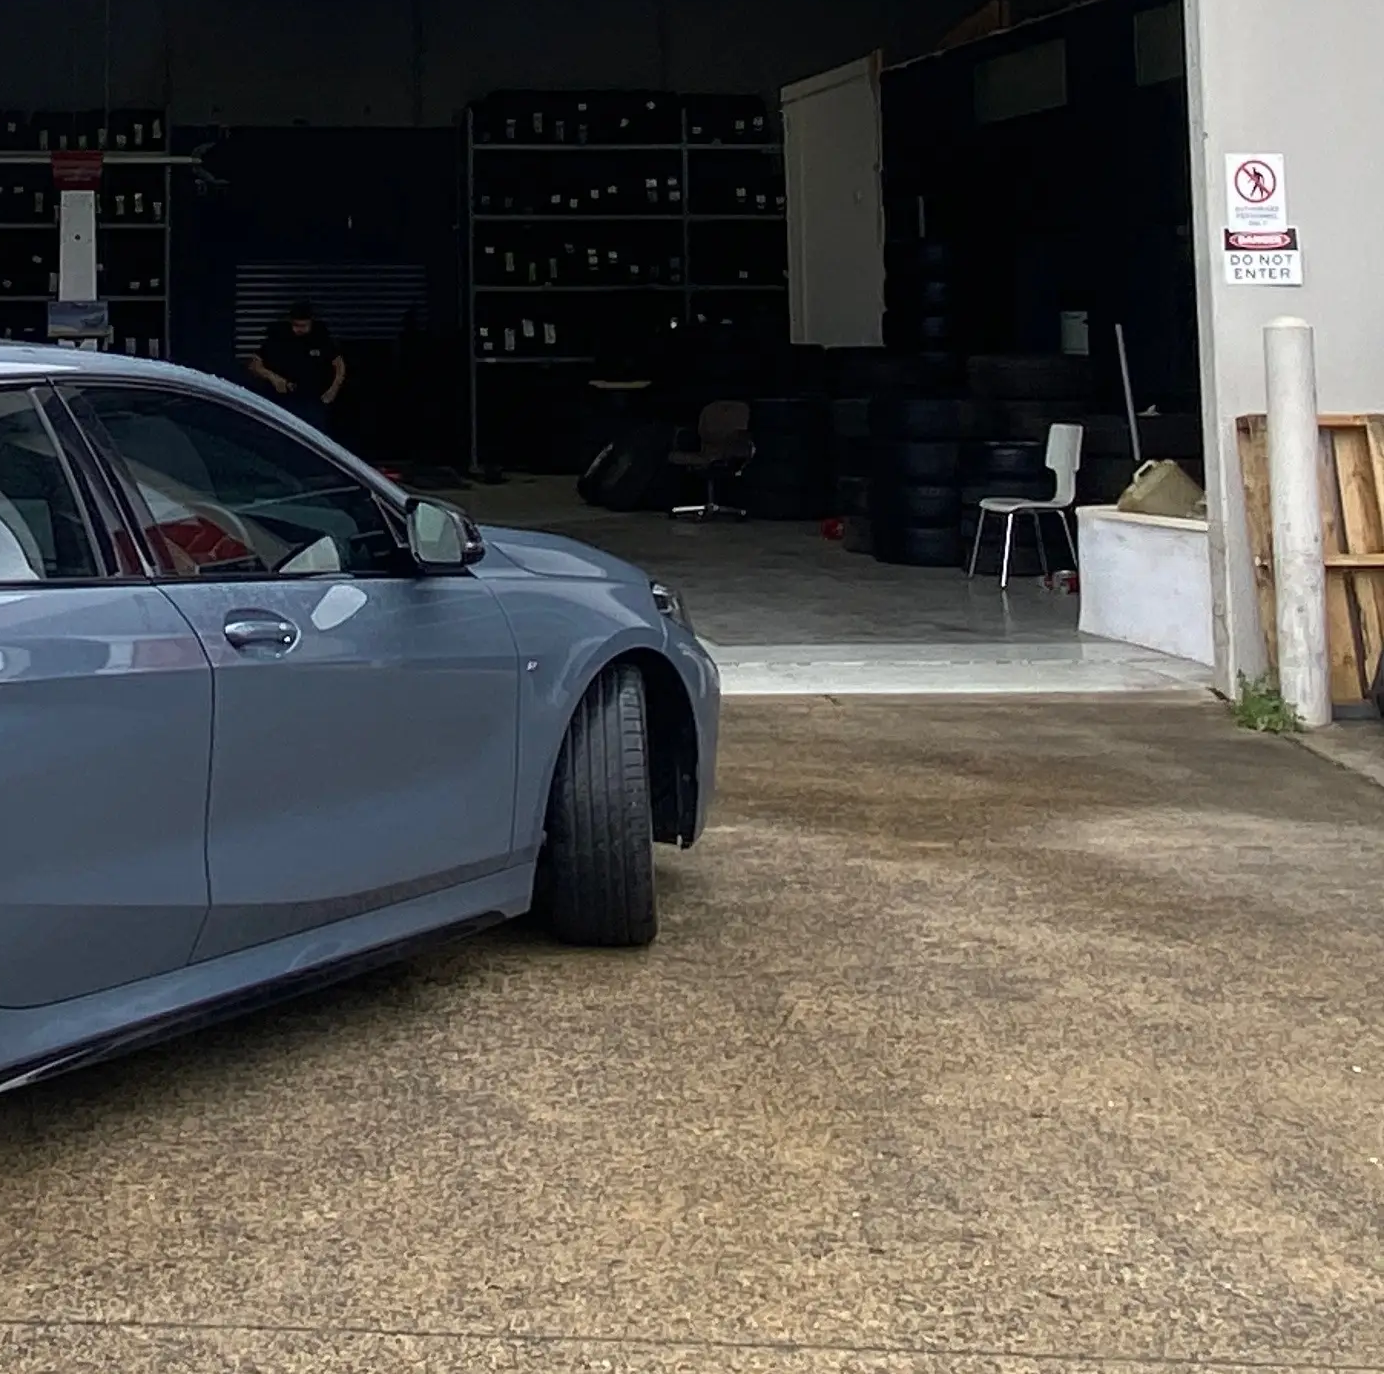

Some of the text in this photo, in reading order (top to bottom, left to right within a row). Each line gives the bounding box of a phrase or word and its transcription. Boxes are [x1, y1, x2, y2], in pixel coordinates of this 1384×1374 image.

[1230, 254, 1293, 266] DO NOT
[1234, 267, 1291, 280] ENTER
